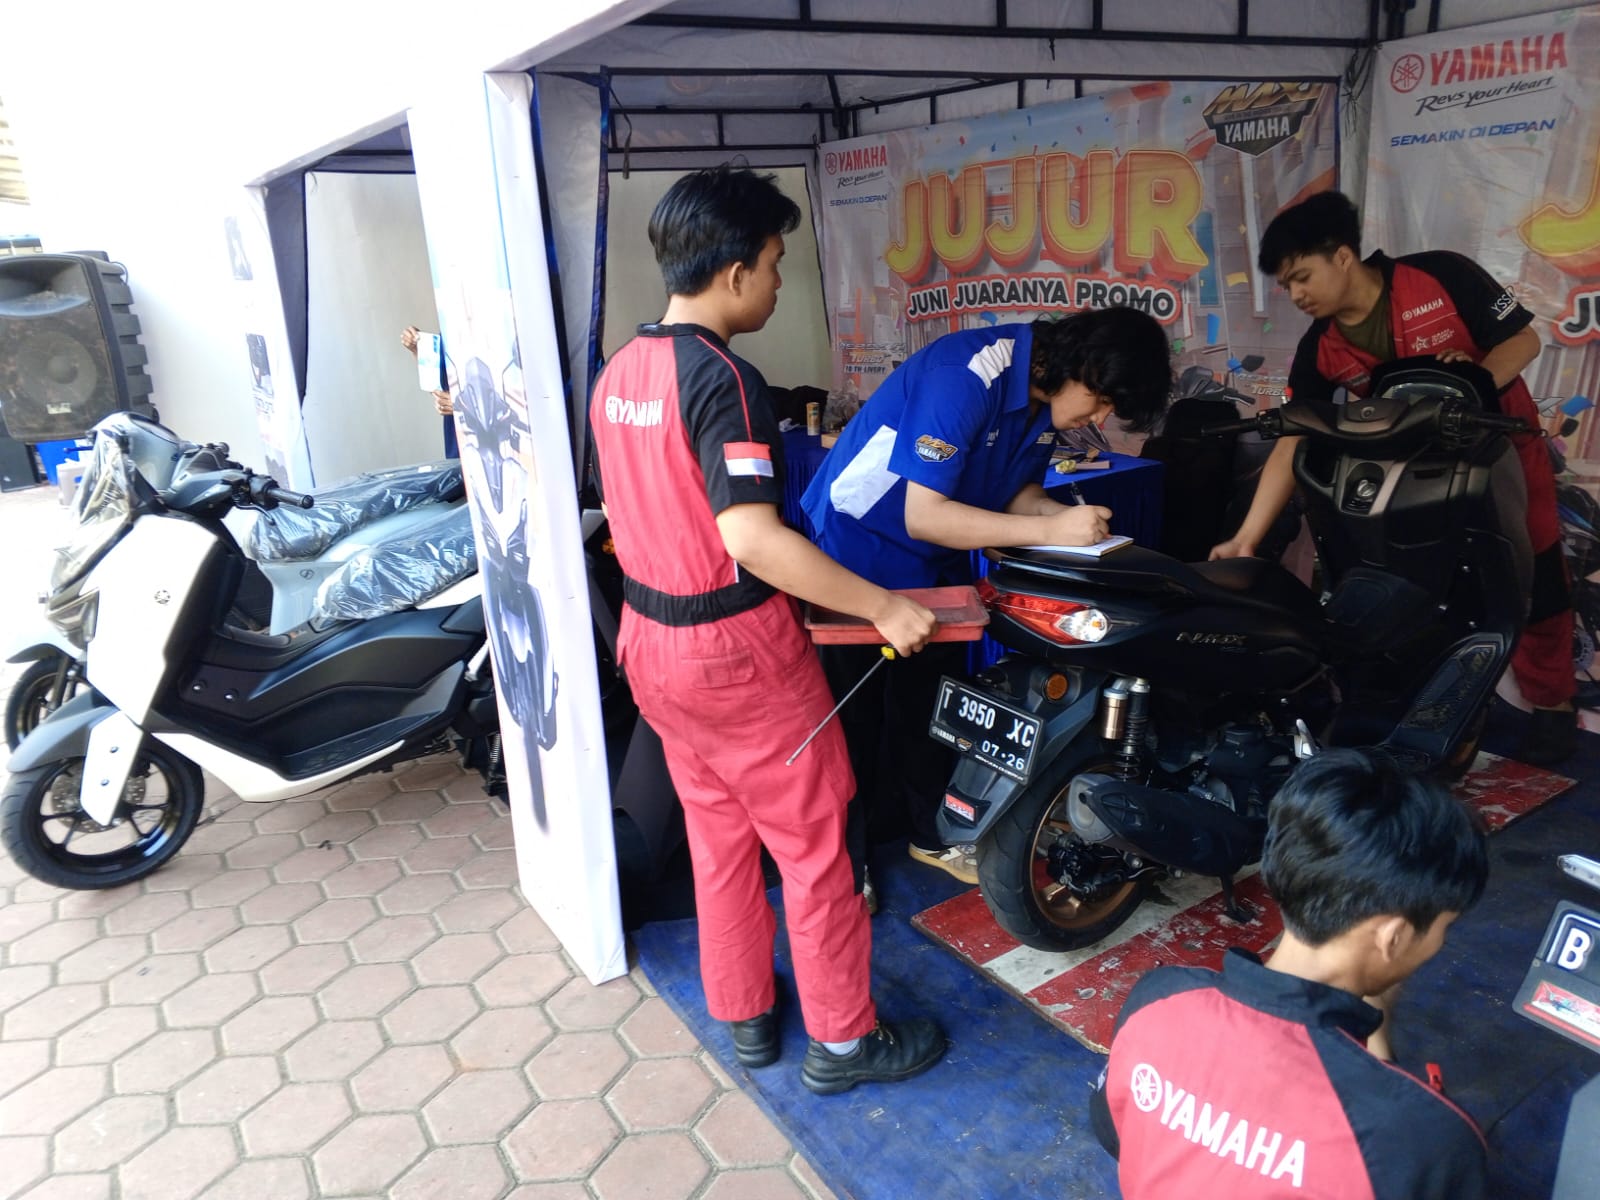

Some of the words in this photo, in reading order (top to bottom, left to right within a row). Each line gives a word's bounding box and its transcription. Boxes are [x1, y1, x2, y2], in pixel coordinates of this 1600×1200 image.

[1430, 32, 1567, 86] YAMAHA
[1415, 90, 1464, 116] Revs
[1464, 87, 1506, 108] your
[1506, 77, 1554, 94] Heart
[1224, 116, 1291, 143] YAMAHA
[1391, 128, 1464, 147] SEMAKIN
[1469, 125, 1485, 138] DI
[1488, 119, 1556, 137] DEPAN
[838, 145, 887, 172] YAMAHA
[885, 150, 1209, 280] JUJUR
[909, 286, 949, 316] JUNI
[954, 279, 1067, 309] JUARANYA
[1076, 281, 1174, 317] PROMO
[1413, 298, 1444, 318] YAMAHA
[944, 688, 953, 709] T
[958, 696, 996, 730] 3950
[1006, 719, 1034, 747] XC
[1557, 926, 1591, 970] B
[1160, 1079, 1306, 1188] YAMAHA
